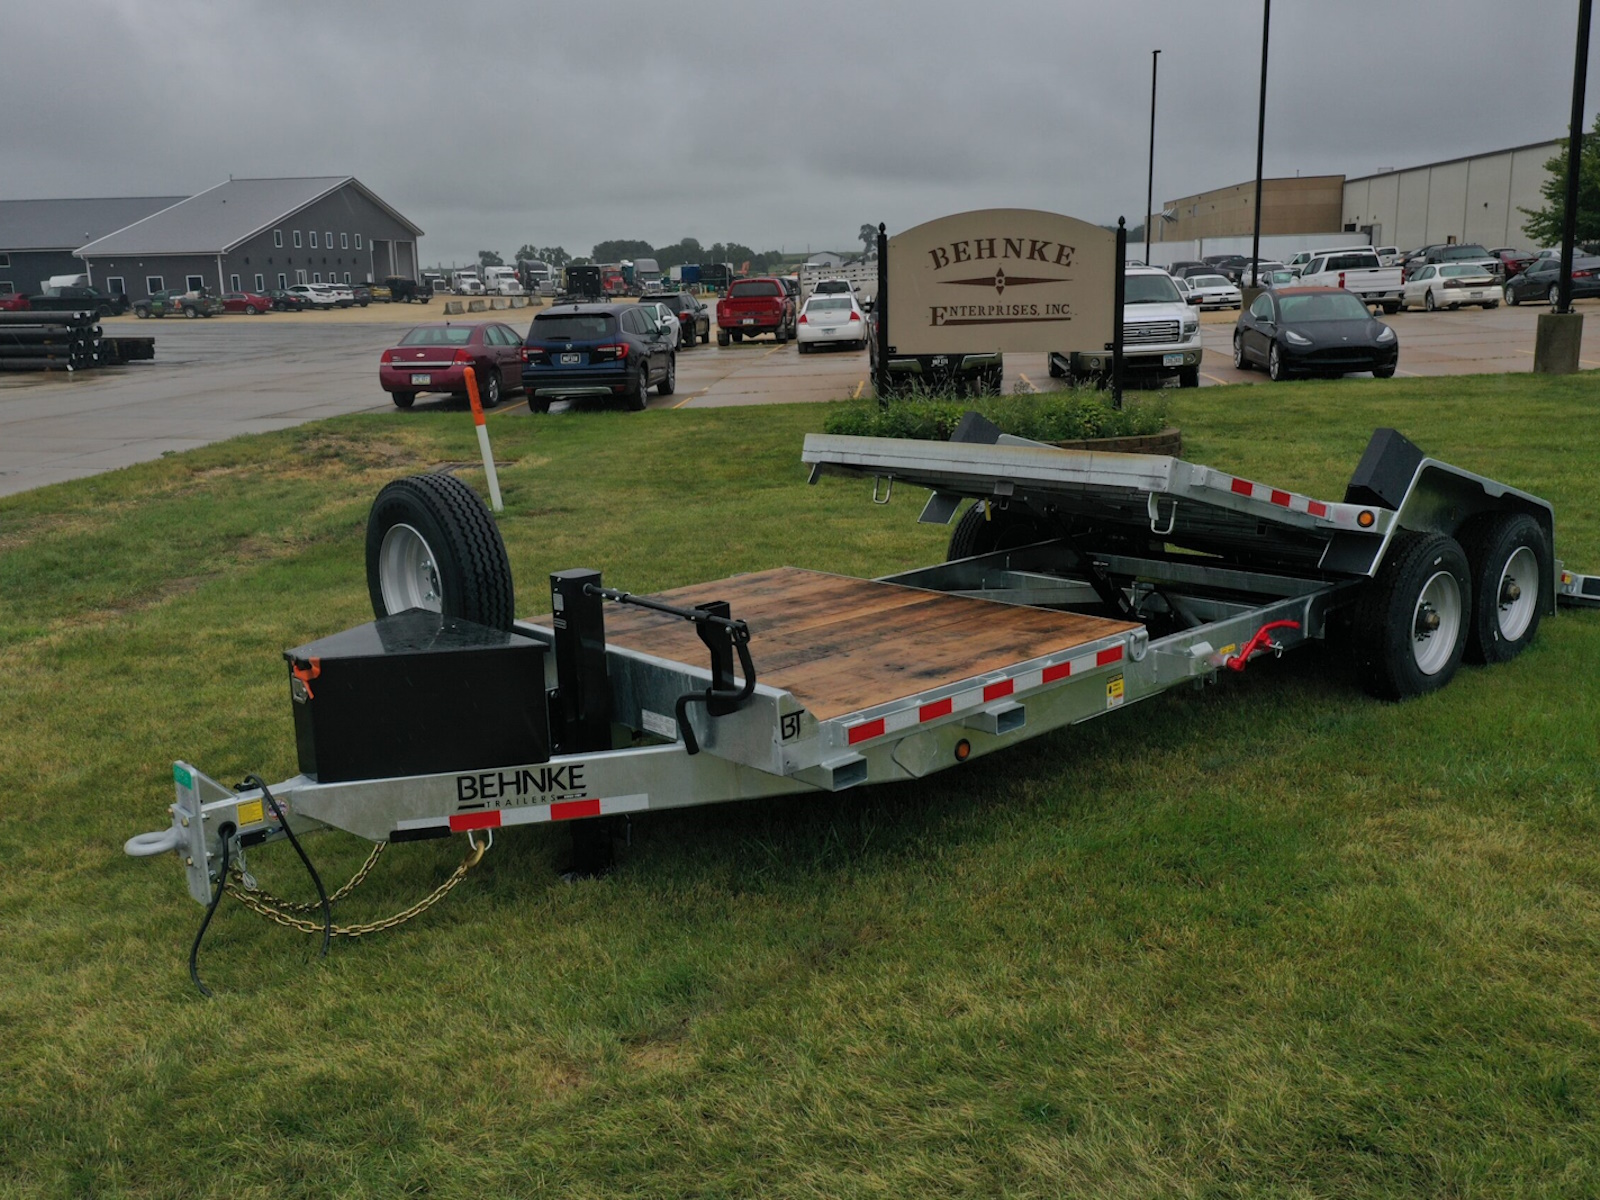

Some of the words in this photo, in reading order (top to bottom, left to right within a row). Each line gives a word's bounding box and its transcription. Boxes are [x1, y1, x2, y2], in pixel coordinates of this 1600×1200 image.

[928, 238, 1076, 271] BEHNKE
[1045, 303, 1073, 316] INC.
[780, 709, 806, 741] BT
[457, 764, 587, 802] BEHNKE
[486, 794, 557, 808] TRAILERS
